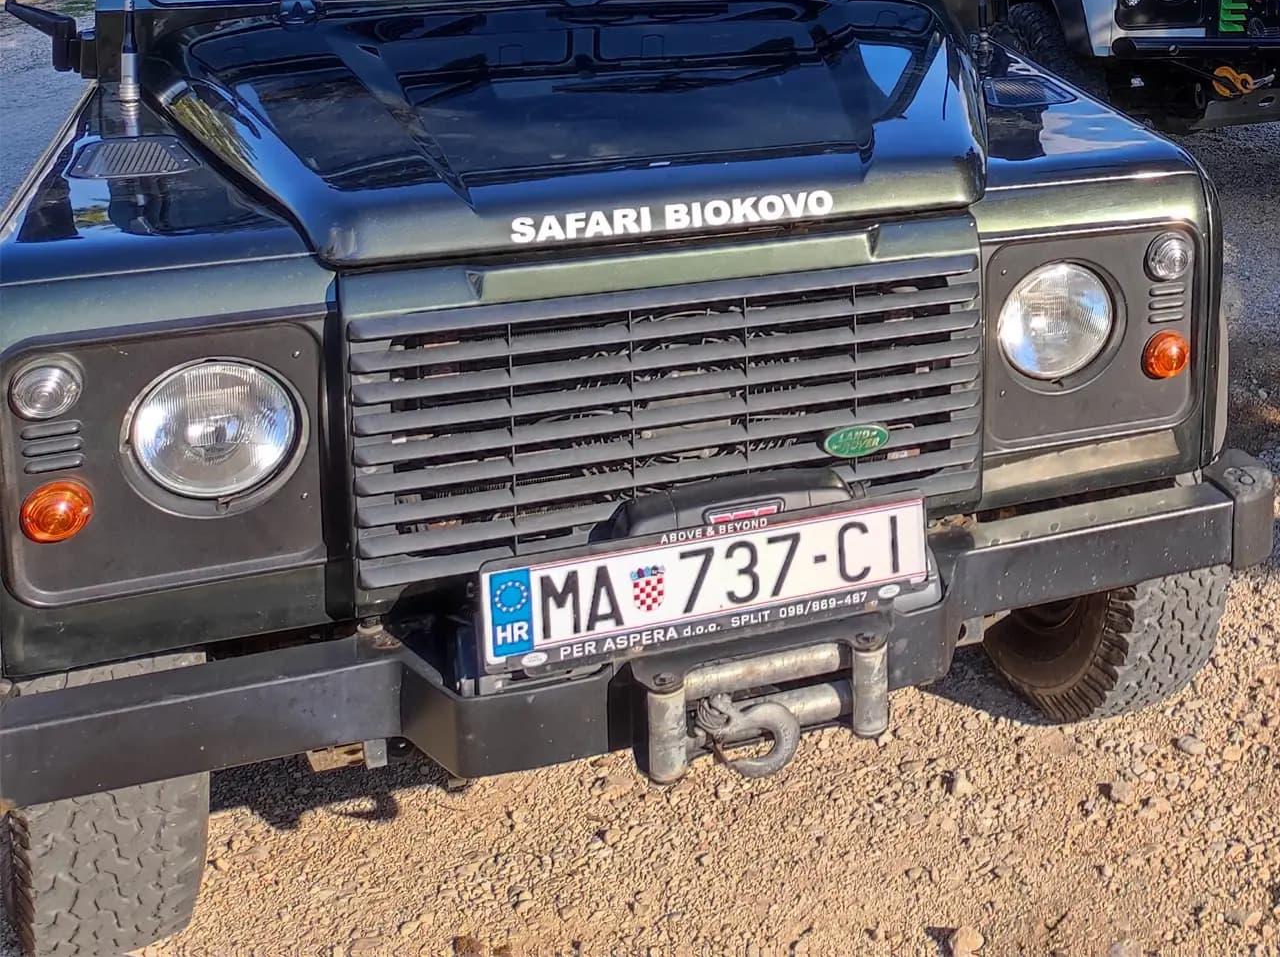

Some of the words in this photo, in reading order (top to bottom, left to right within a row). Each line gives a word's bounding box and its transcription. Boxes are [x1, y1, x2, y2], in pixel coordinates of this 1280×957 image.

[511, 206, 652, 243] SAFARI
[664, 190, 834, 230] BIOKOVO
[839, 429, 869, 443] LAND
[660, 527, 702, 545] ABOVE
[706, 526, 715, 537] &
[719, 517, 768, 534] BEYOND
[539, 565, 625, 640] MA
[496, 620, 529, 646] HR
[560, 641, 596, 661] PER
[603, 630, 678, 652] ASPERA
[731, 609, 771, 628] SPLIT
